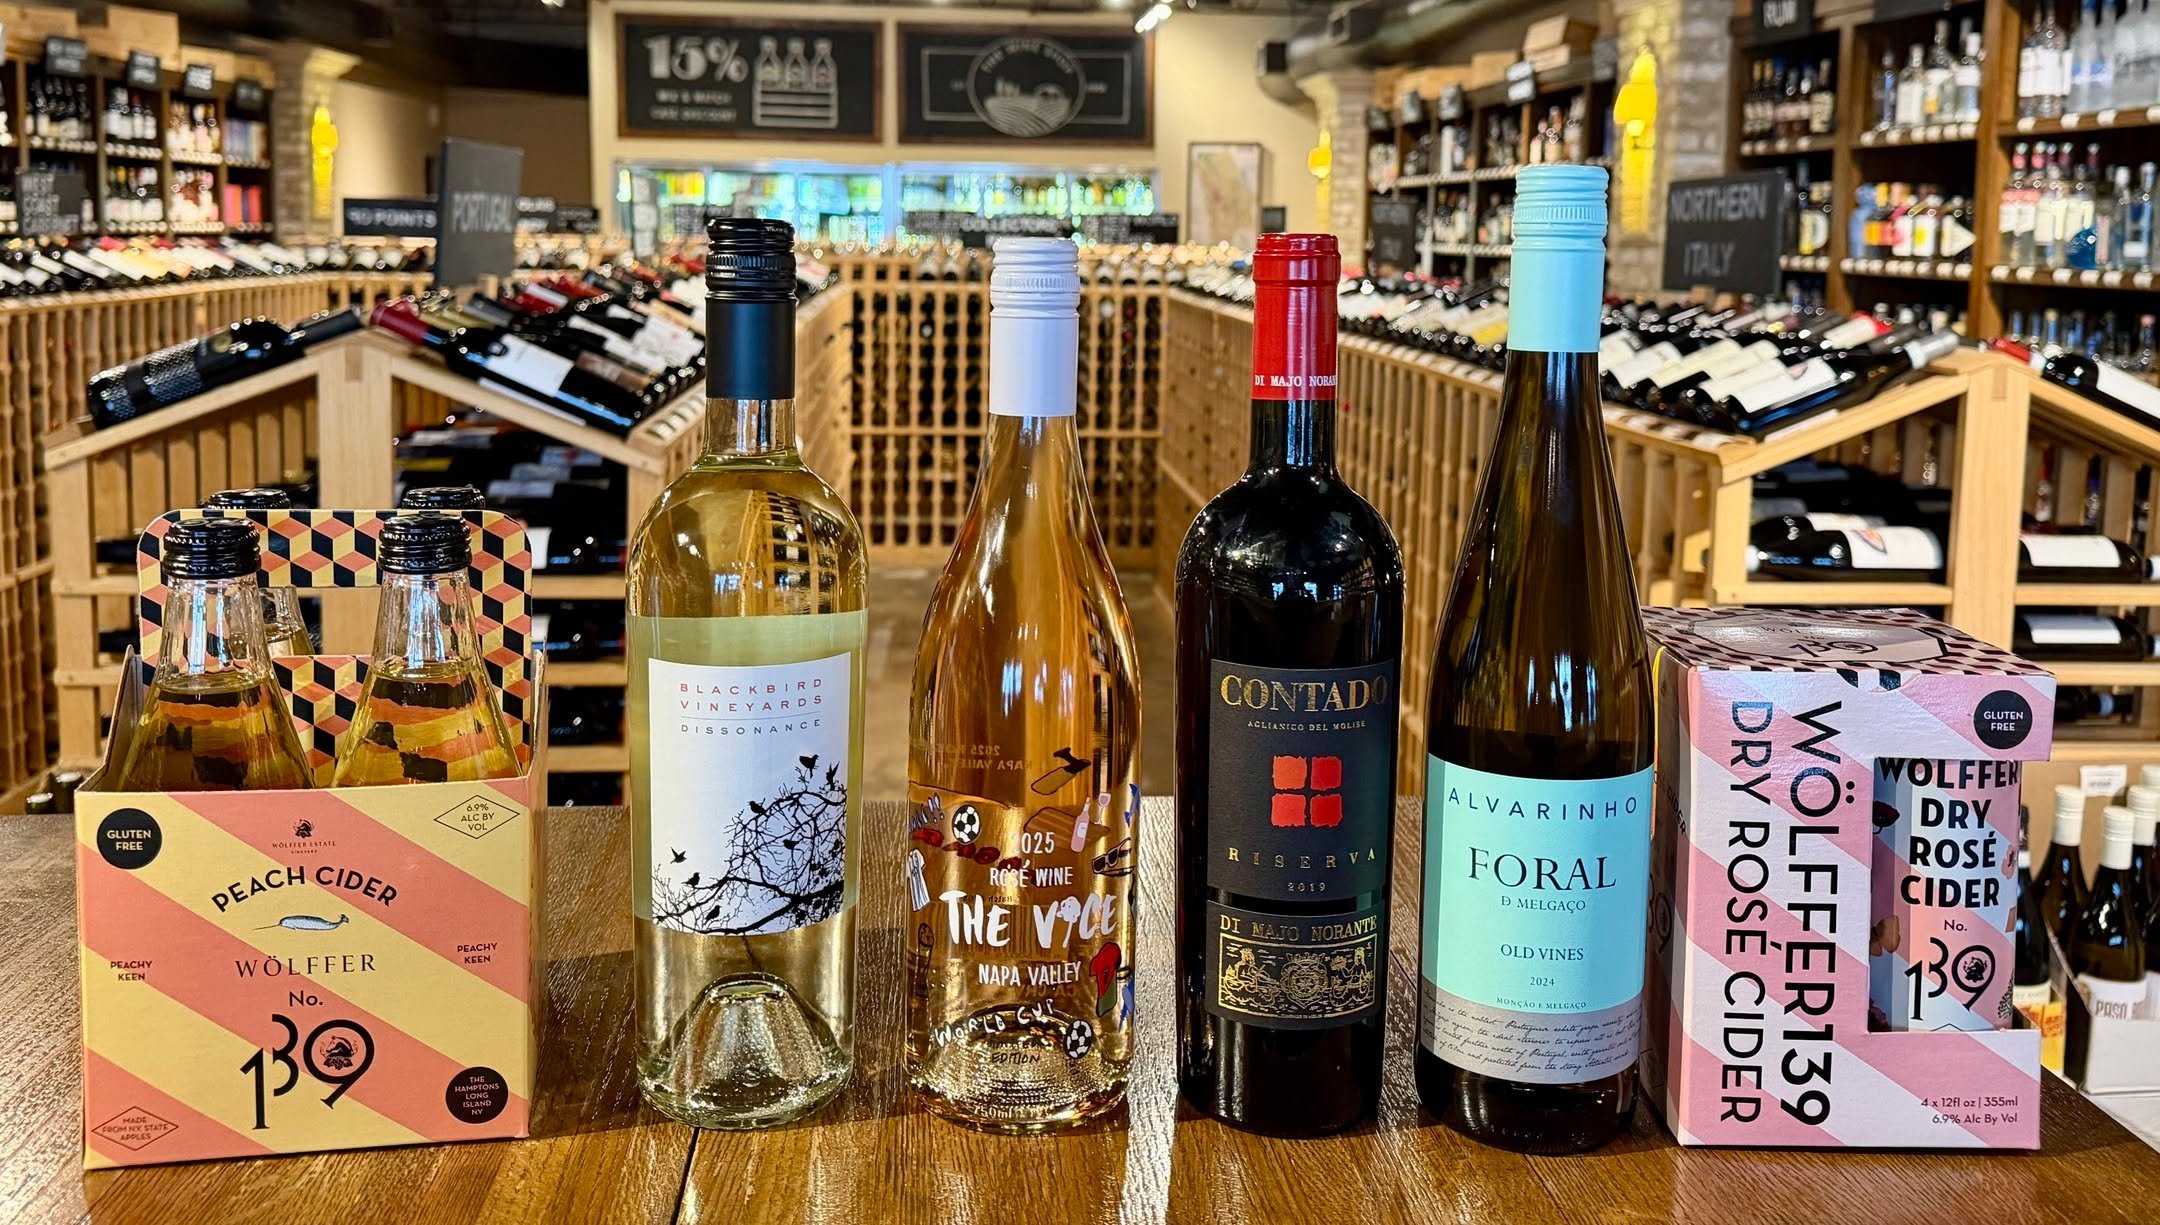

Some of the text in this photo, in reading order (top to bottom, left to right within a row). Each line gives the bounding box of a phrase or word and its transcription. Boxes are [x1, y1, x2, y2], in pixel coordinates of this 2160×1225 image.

[1763, 0, 1798, 27] RUM
[643, 34, 749, 82] 15%
[22, 173, 55, 192] WEST
[23, 194, 60, 214] COAST
[1671, 184, 1767, 222] NORTHERN
[375, 209, 438, 227] POINTS
[453, 192, 515, 233] PORTUGAL
[1684, 243, 1734, 277] ITALY
[1255, 375, 1264, 385] DI
[1271, 375, 1302, 387] MAJO
[680, 678, 822, 695] BLACKBIRD
[1220, 674, 1388, 712] CONTADO
[680, 695, 822, 712] VINEYARDS
[1983, 711, 2024, 720] GLUTEN
[681, 719, 821, 735] DISSONANCE
[1248, 720, 1304, 731] AGLIANICO
[1333, 720, 1366, 730] MOLISE
[1991, 722, 2016, 731] FREE
[466, 803, 489, 812] 6.9%
[1449, 787, 1637, 820] ALVARINHO
[460, 812, 495, 822] ALC BY
[1920, 797, 1992, 829] DRY
[106, 829, 152, 839] GLUTEN
[468, 823, 488, 831] VOL
[115, 842, 144, 851] FREE
[1012, 832, 1055, 854] 2025
[1909, 830, 1997, 869] ROSÉ
[1228, 847, 1376, 869] RISERVA
[990, 859, 1073, 888] ROSÉ WINE
[1468, 846, 1617, 891] FORAL
[211, 865, 397, 913] PEACH CIDER
[1288, 882, 1326, 892] 2019
[1900, 875, 2000, 909] CIDER
[1517, 898, 1586, 914] MELGAÇO
[1720, 700, 1782, 1123] DRY ROSÉ CIDER
[939, 890, 1011, 947] THE
[1943, 919, 1968, 932] No.
[1220, 914, 1378, 942] DI MAJO NORANTE
[457, 942, 498, 953] PEACHY
[1500, 943, 1584, 962] OLD VINES
[110, 960, 153, 970] PEACHY
[235, 953, 376, 978] WÖLFFER
[464, 955, 491, 964] KEEN
[118, 973, 146, 982] KEEN
[979, 961, 1081, 986] NAPA VALLEY
[1529, 976, 1555, 987] 2024
[1904, 936, 1996, 1021] 139
[289, 990, 324, 1007] No.
[1496, 996, 1536, 1009] MONÇÃO
[935, 998, 1054, 1048] WORLD CUP
[992, 1051, 1040, 1065] EDITION
[240, 1014, 375, 1130] 139
[454, 1083, 500, 1092] HAMPTONS
[465, 1092, 489, 1100] LONG
[463, 1100, 491, 1108] ISLAND
[1921, 1097, 1929, 1108] 4
[1931, 1099, 1940, 1108] x
[1963, 1099, 1976, 1108] oz
[1984, 1096, 2018, 1108] 355ml
[1932, 1112, 2018, 1126] 6.9% Alc By Vol
[144, 1124, 168, 1132] STATE
[121, 1133, 151, 1141] APPLES
